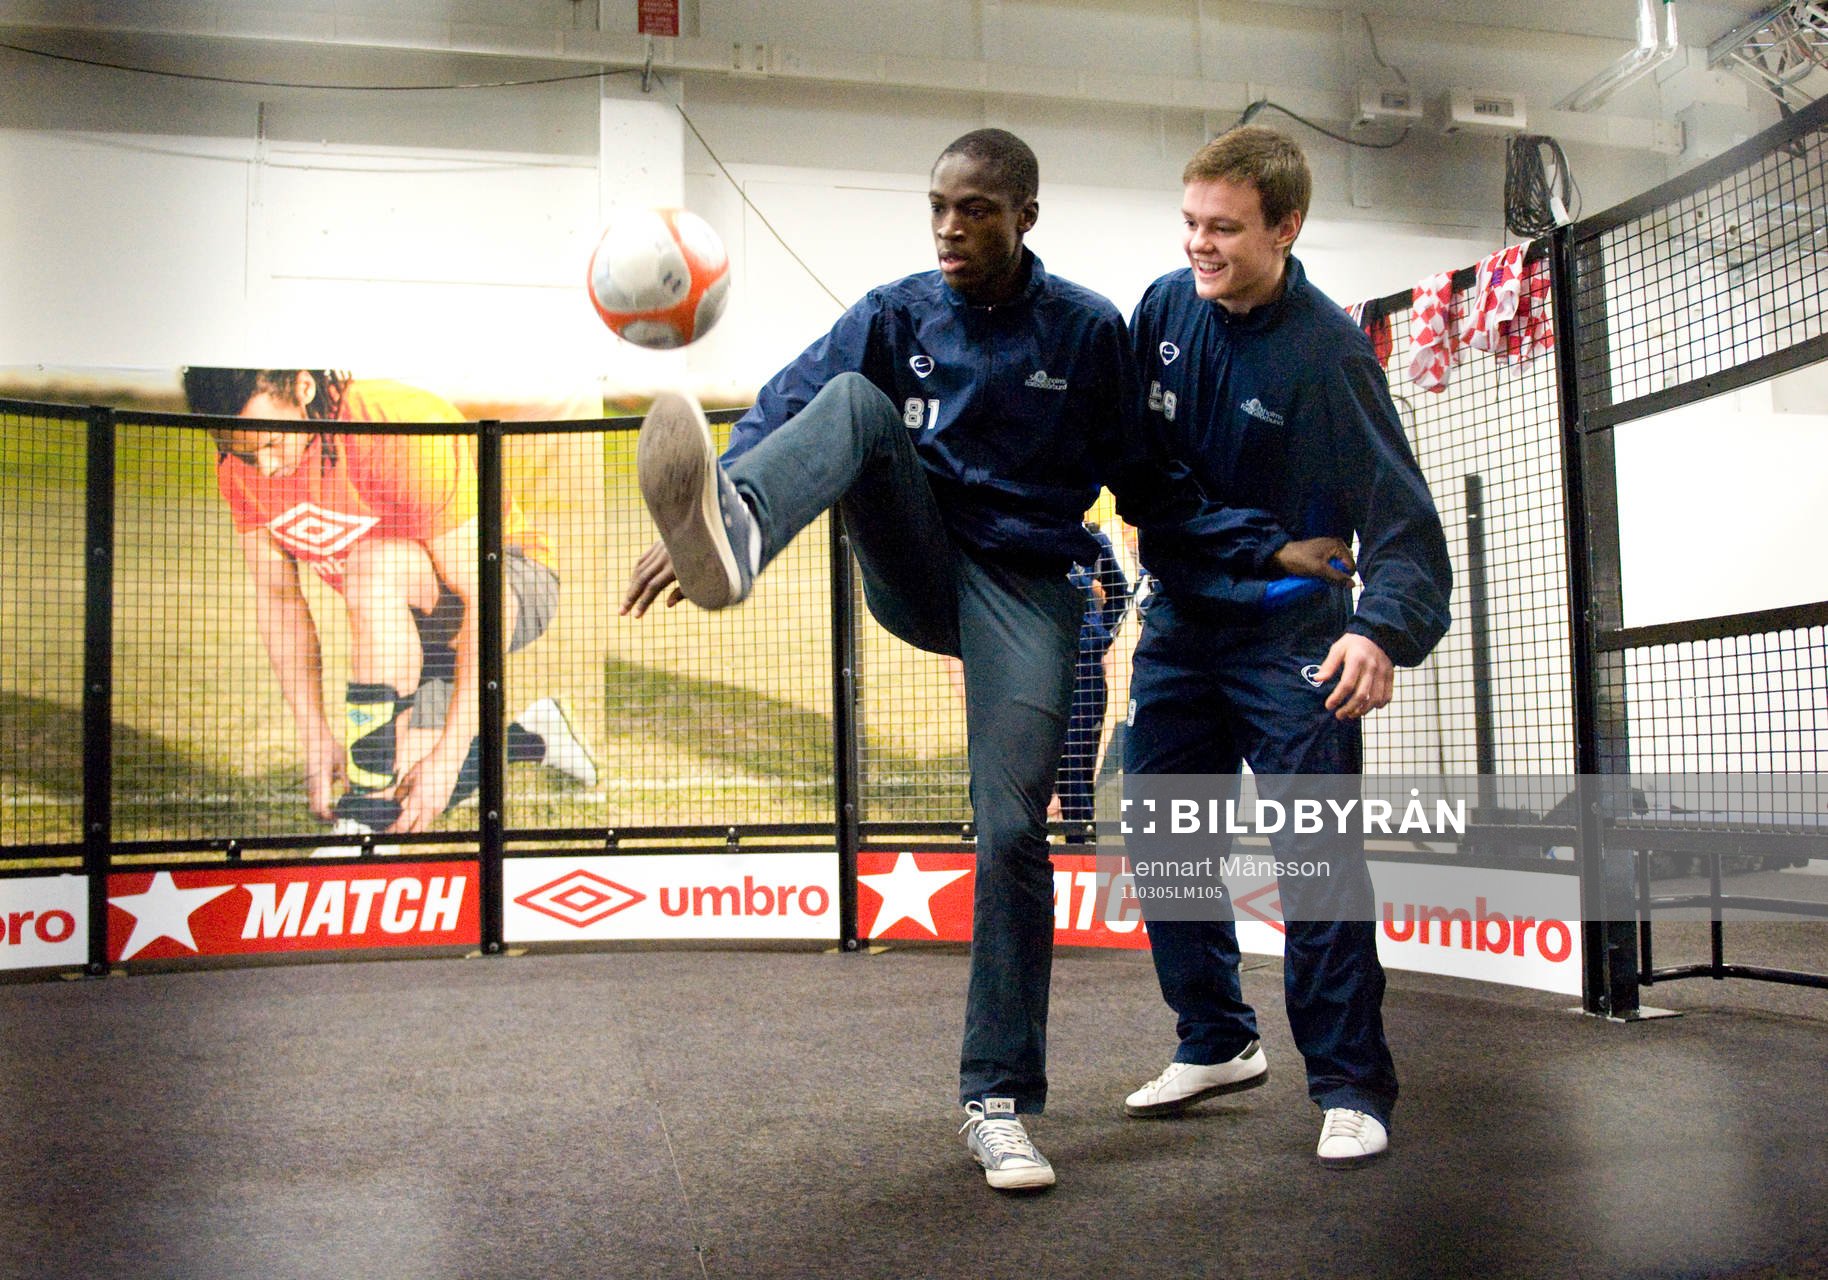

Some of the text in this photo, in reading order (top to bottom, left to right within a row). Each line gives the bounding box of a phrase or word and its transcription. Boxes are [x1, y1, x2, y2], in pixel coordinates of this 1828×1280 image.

[903, 397, 940, 430] 81
[241, 875, 467, 940] MATCH
[659, 875, 830, 917] umbro
[0, 909, 76, 945] ro
[1383, 896, 1572, 963] umbro
